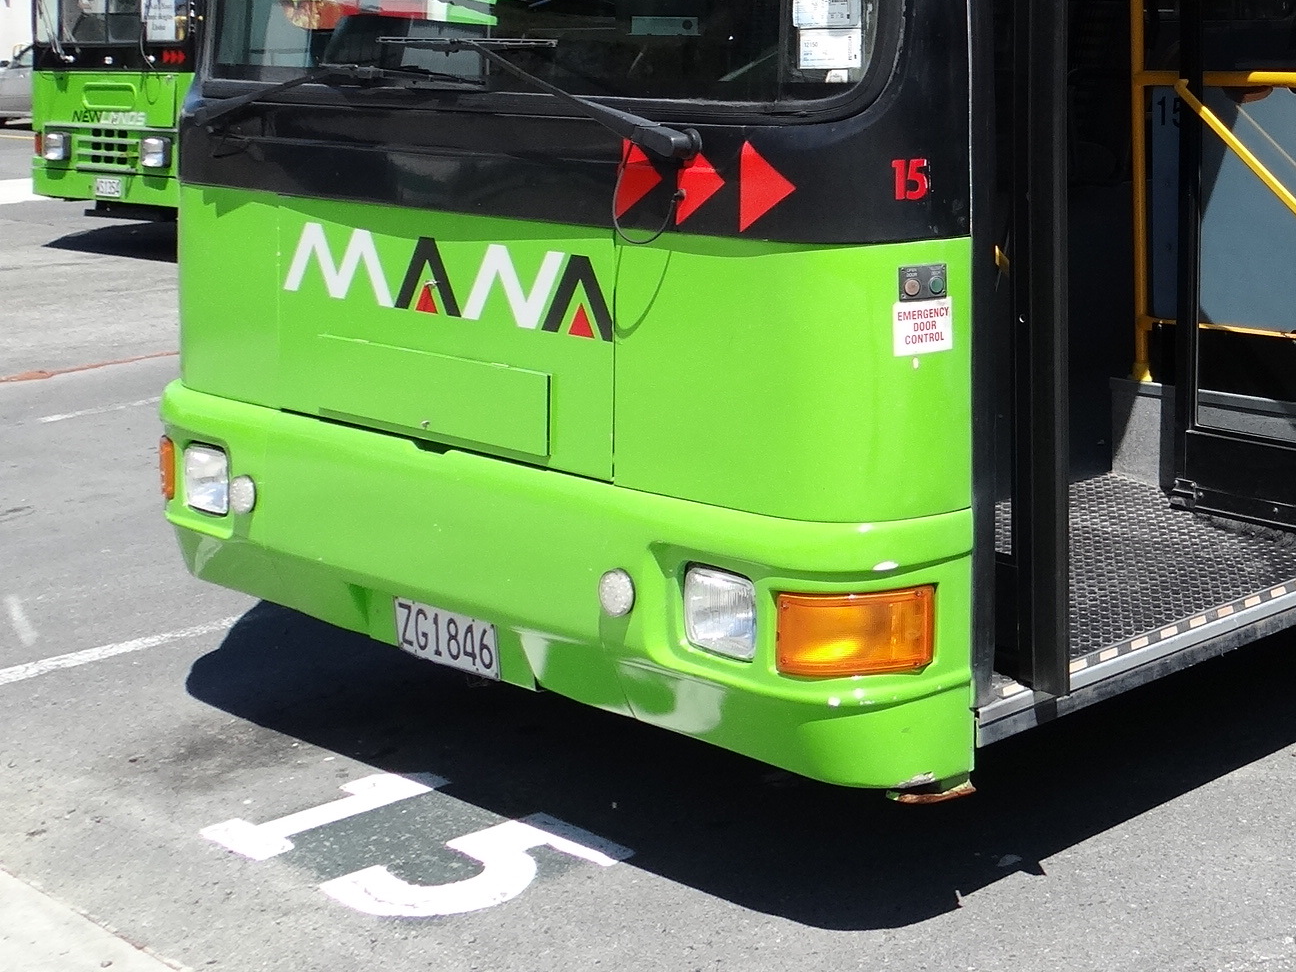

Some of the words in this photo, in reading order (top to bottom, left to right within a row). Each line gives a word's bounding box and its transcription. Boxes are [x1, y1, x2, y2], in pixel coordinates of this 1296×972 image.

[892, 158, 928, 201] 15
[283, 221, 614, 343] MANA
[897, 306, 950, 322] EMERGENCY
[913, 319, 937, 332] DOOR
[904, 331, 945, 345] CONTROL
[398, 601, 493, 670] ZG1846
[199, 771, 636, 918] 15
